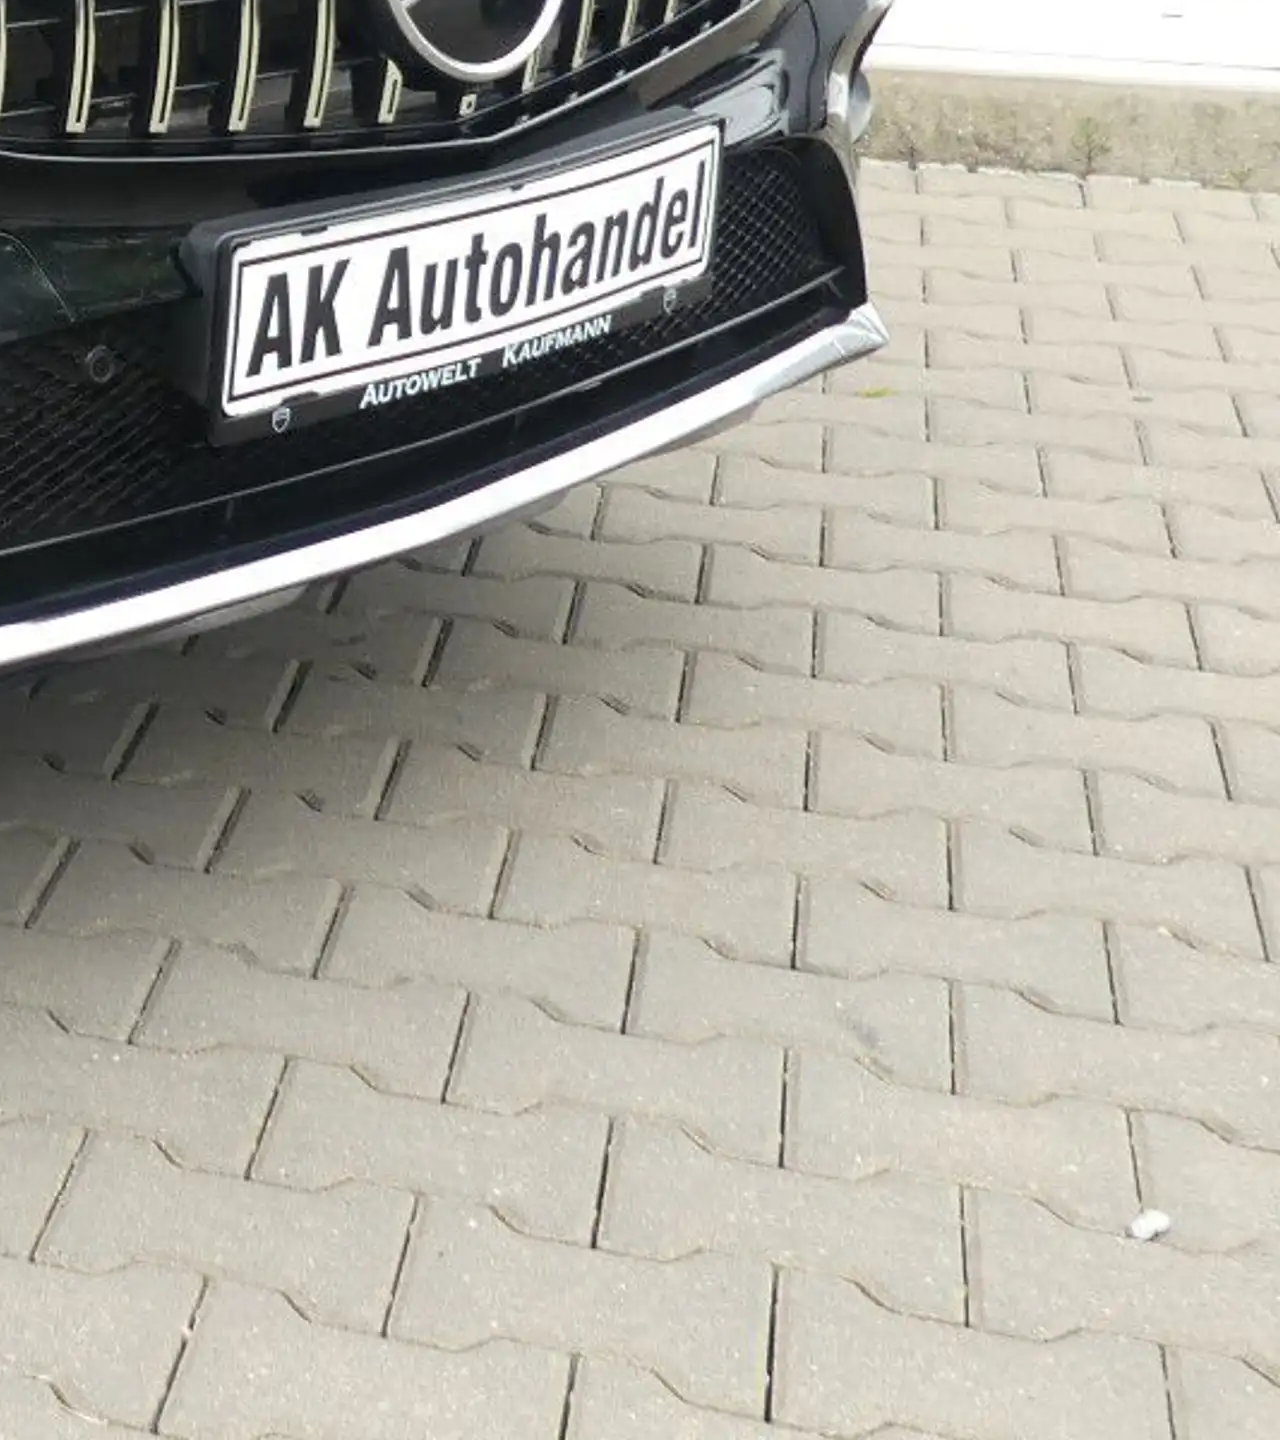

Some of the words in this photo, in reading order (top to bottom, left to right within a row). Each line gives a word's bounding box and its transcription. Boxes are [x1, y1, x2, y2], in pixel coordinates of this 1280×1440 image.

[245, 257, 350, 378] AK
[367, 160, 707, 348] Autohandel
[359, 357, 482, 409] AUTOWELT
[502, 315, 612, 368] KAUFMANN
